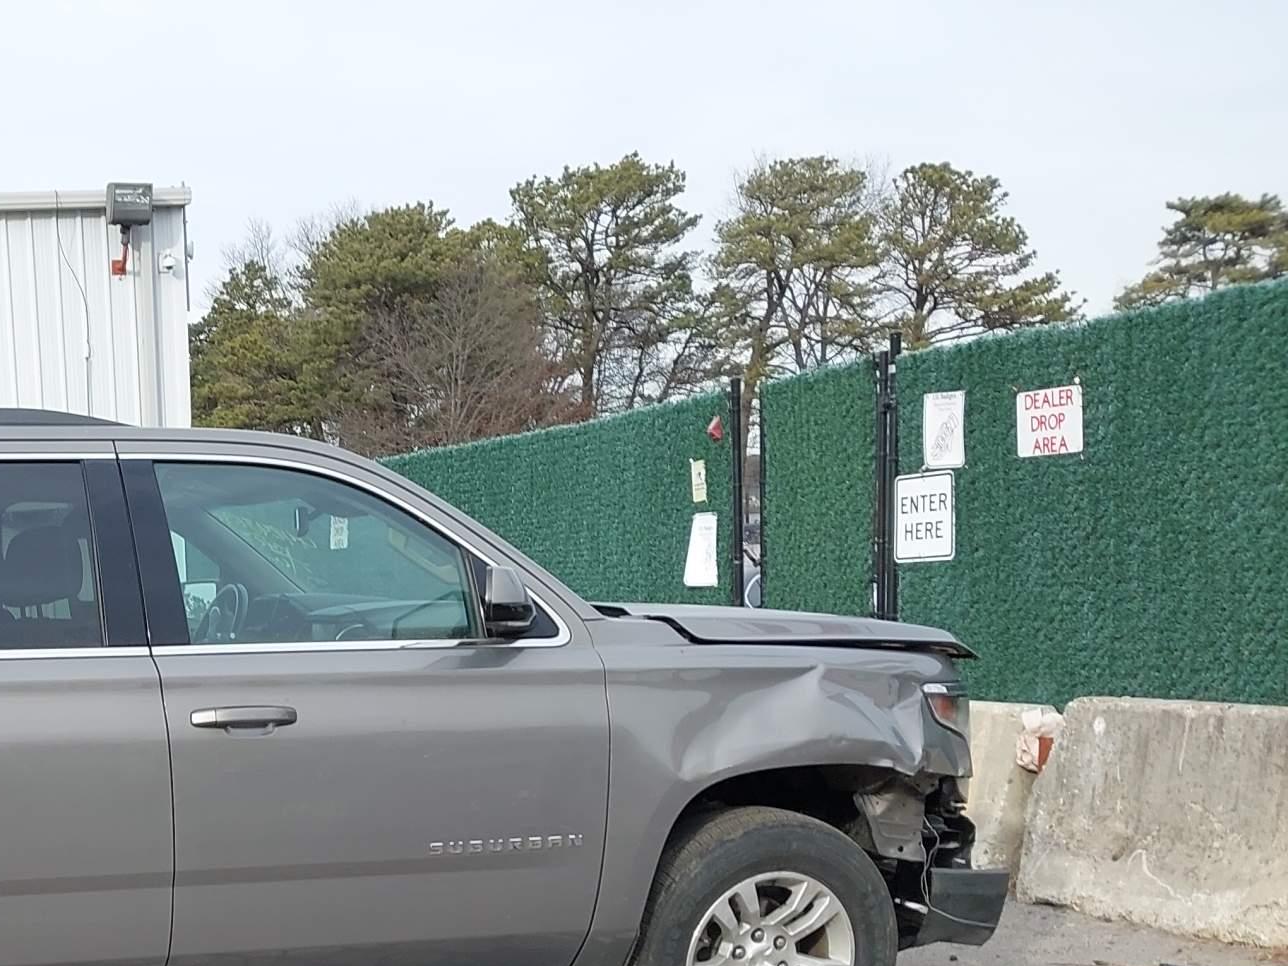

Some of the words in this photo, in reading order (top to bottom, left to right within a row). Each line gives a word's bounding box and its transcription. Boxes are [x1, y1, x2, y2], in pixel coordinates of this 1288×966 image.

[1024, 389, 1074, 411] DEALER
[1030, 412, 1066, 432] DROP
[1032, 435, 1069, 455] AREA
[900, 492, 948, 515] ENTER
[904, 520, 944, 541] HERE
[429, 834, 584, 856] SUBURBAN
